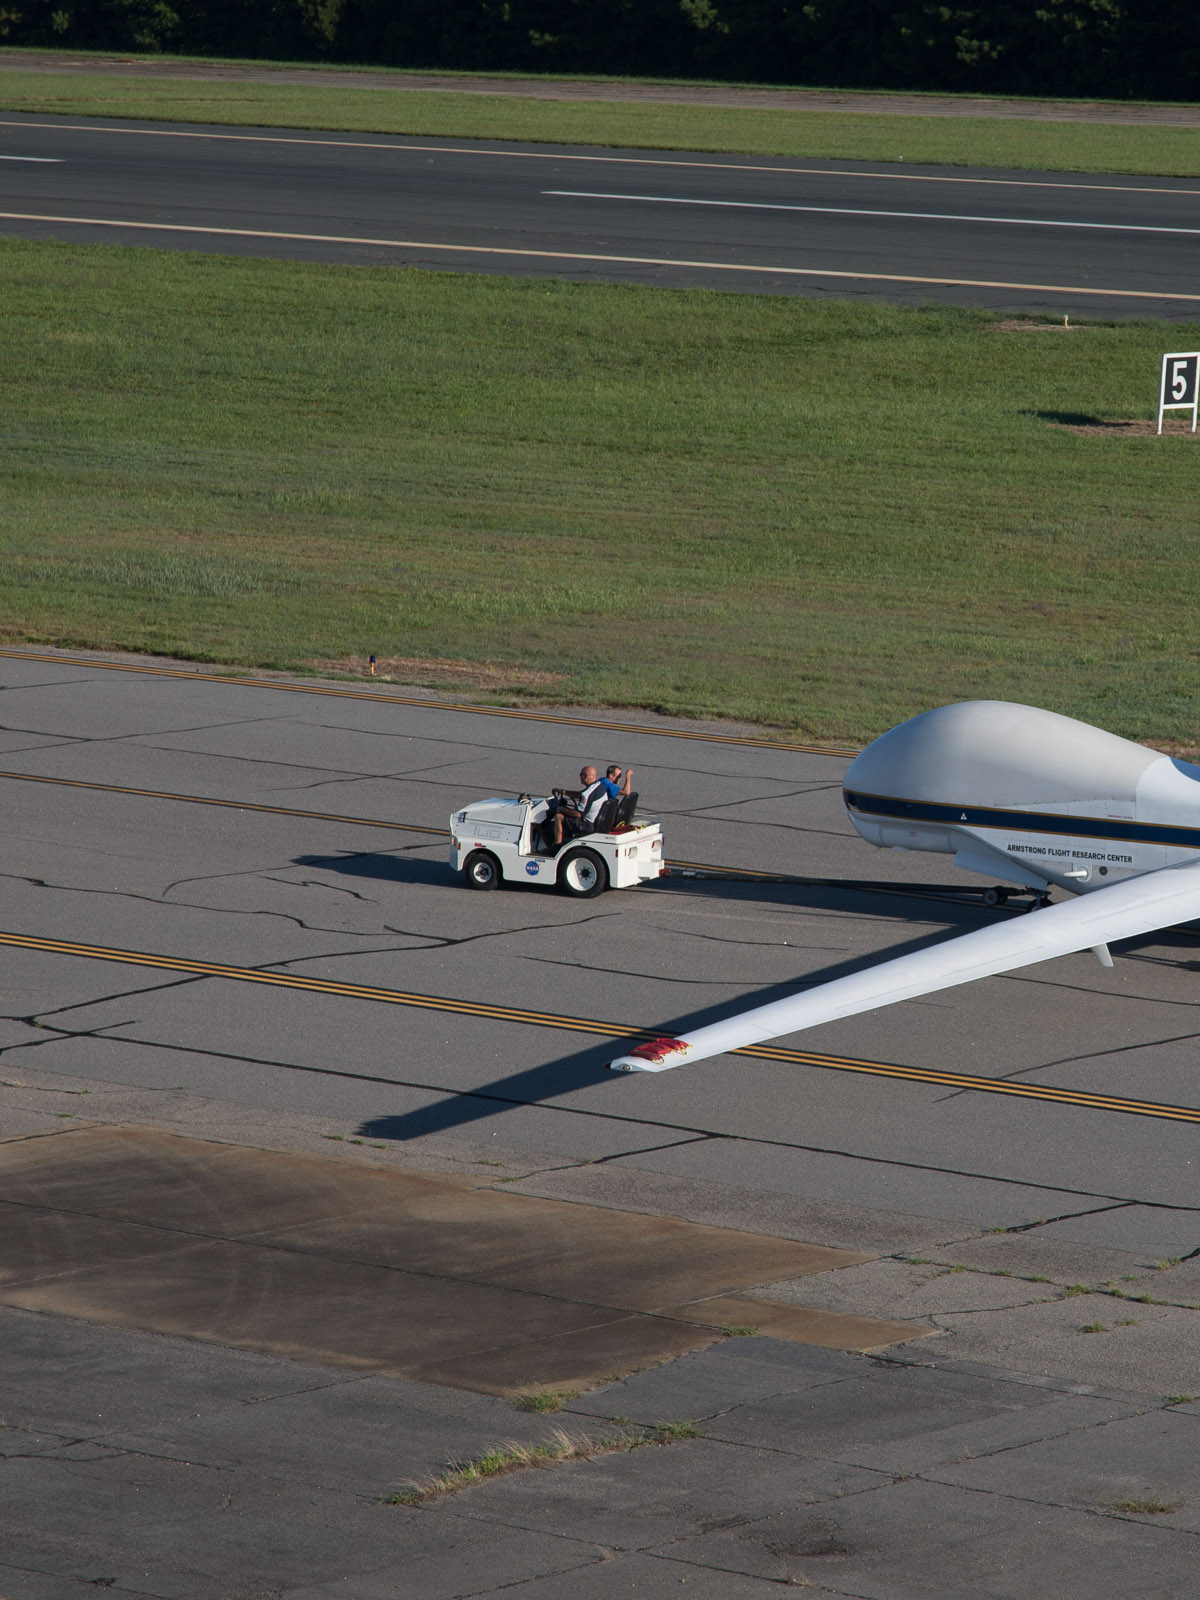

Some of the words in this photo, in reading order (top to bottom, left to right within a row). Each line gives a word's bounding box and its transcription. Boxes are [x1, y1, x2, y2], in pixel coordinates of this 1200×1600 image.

[1172, 361, 1187, 400] 5
[1007, 844, 1046, 855] ARMSTRONG
[1047, 848, 1070, 857] FLIGHT
[1072, 851, 1106, 860] RESEARCH
[1106, 854, 1132, 863] CENTER
